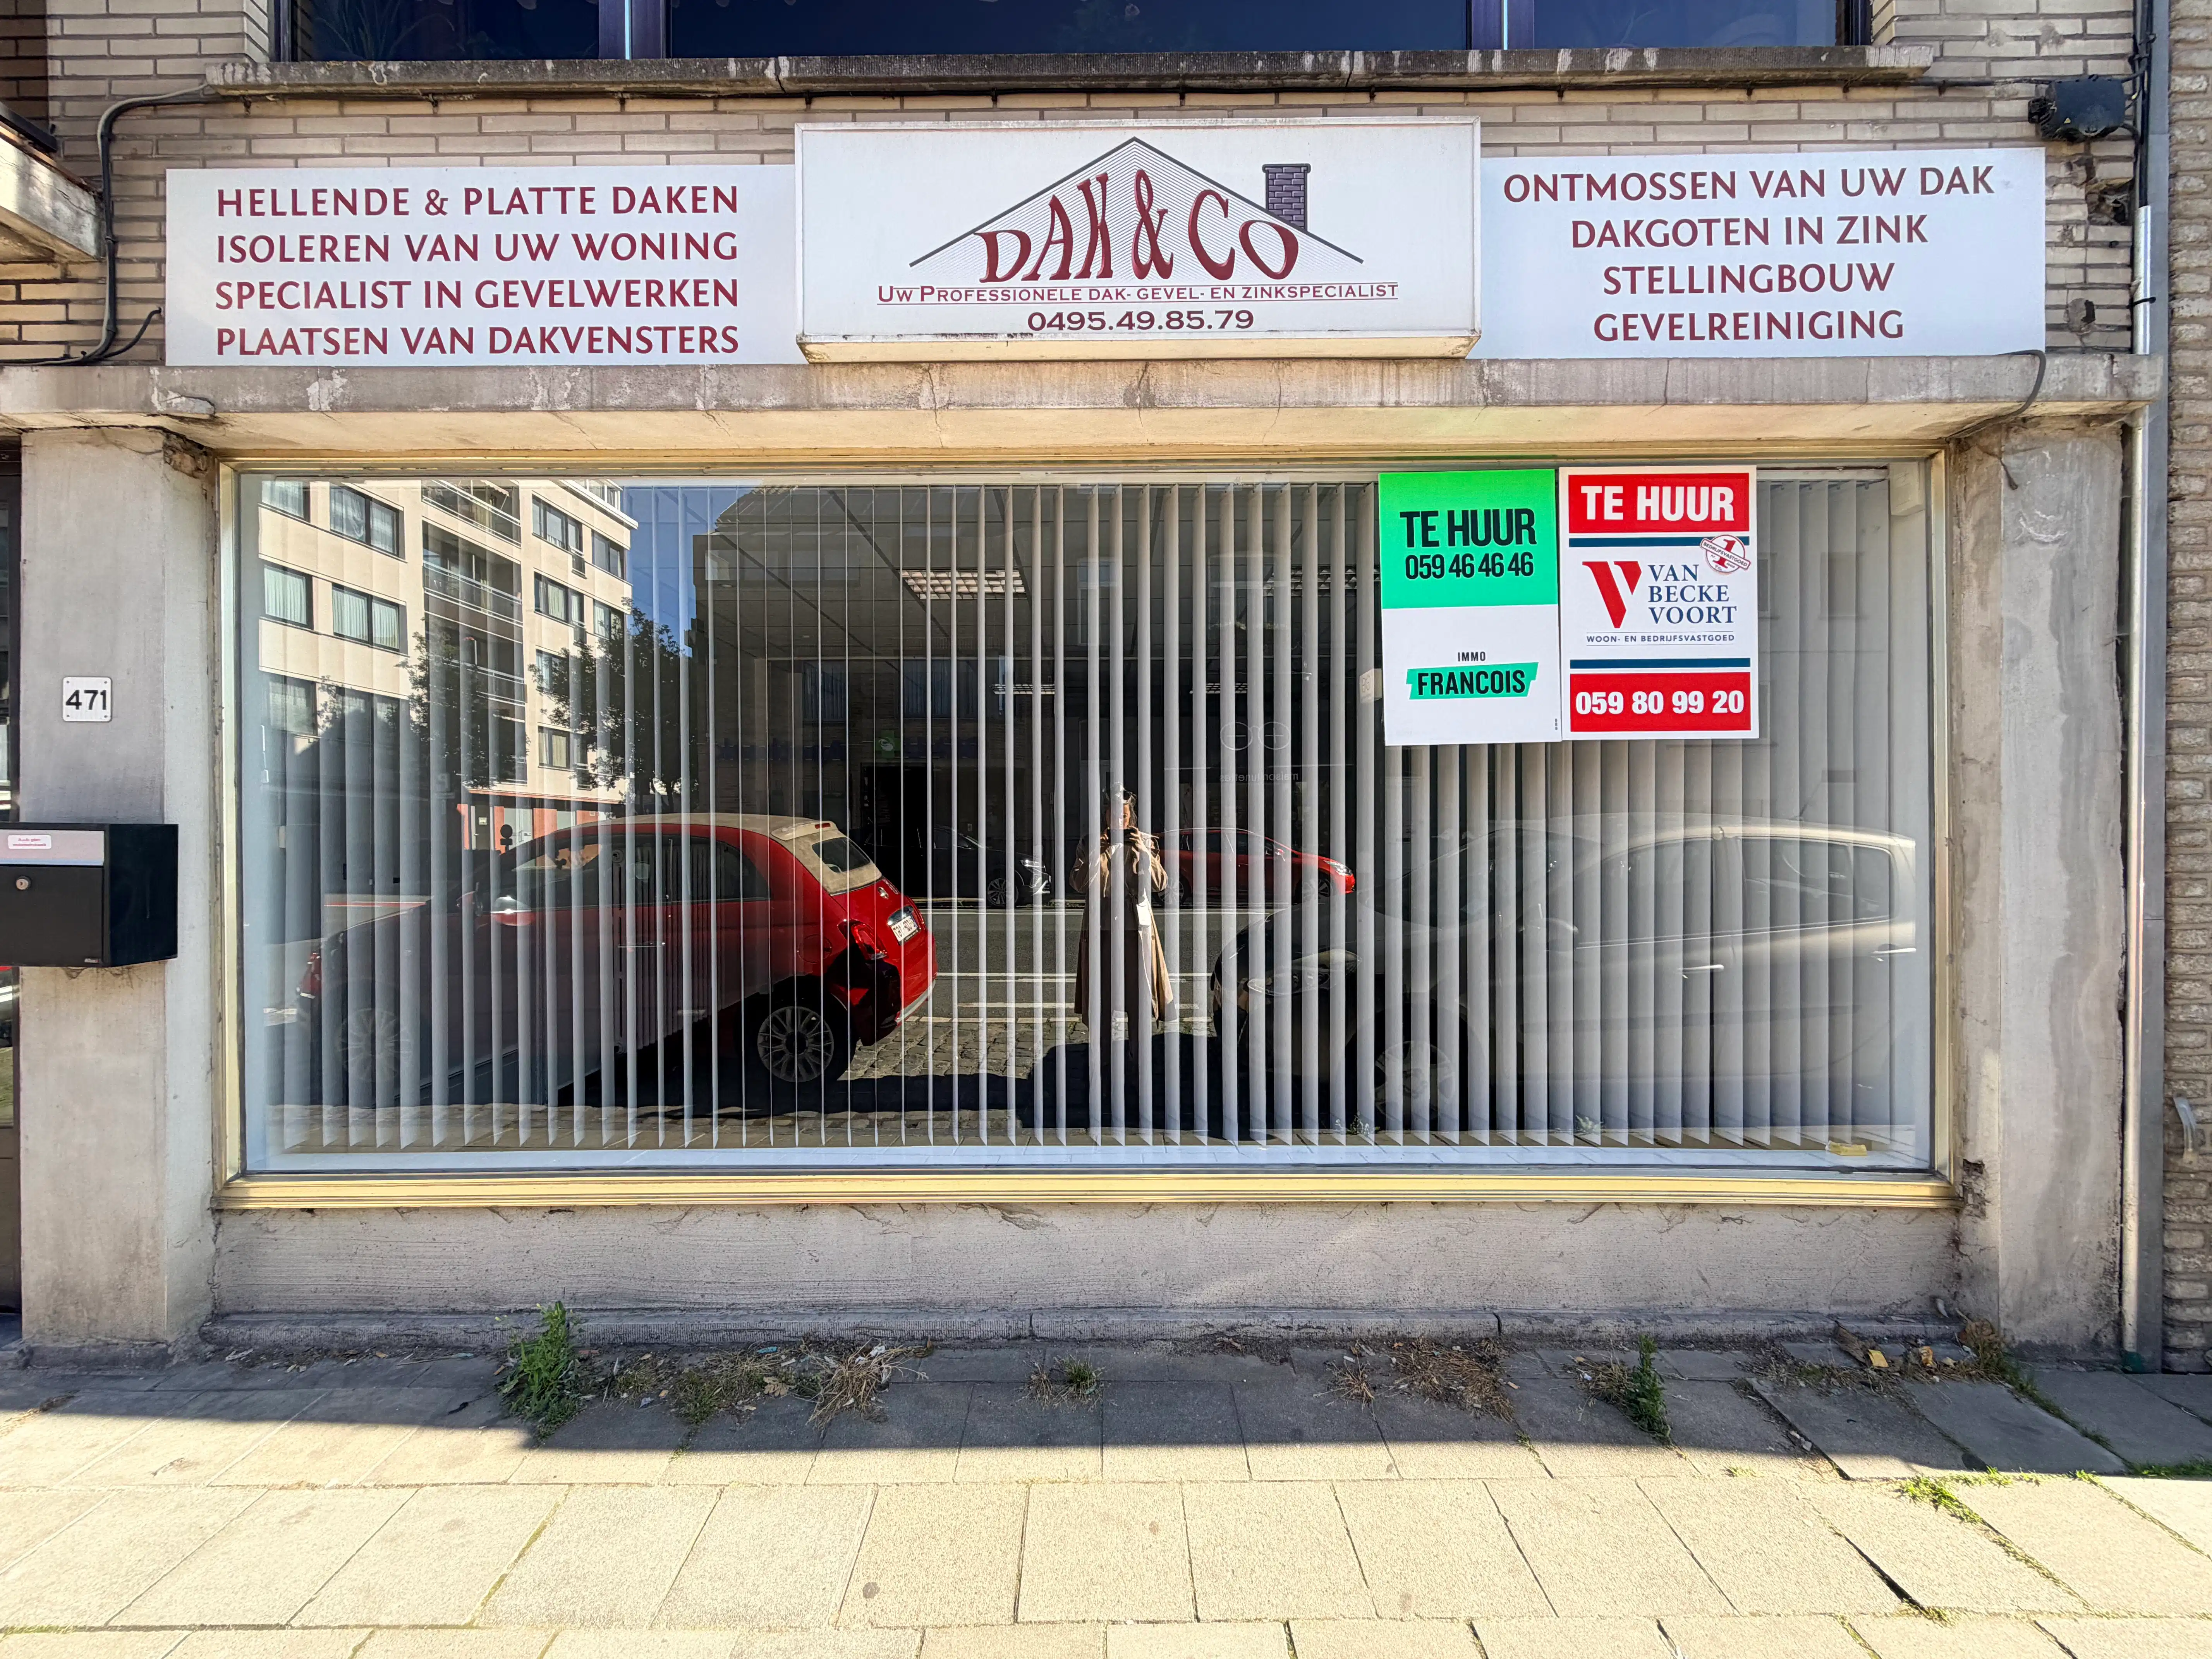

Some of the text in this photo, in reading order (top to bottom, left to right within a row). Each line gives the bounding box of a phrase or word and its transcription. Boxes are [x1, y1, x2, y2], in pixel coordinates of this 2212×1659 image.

[1504, 166, 1994, 203] ONTMOSSEN VAN UW DAK
[218, 186, 737, 216] HELLENDE & PLATTE DAKEN
[978, 170, 1298, 282] DAK & CO
[1572, 214, 1928, 248] DAKGOTEN IN ZINK
[219, 233, 737, 263] ISOLEREN VAN UW WONING
[920, 285, 1082, 302] PROFESSIONELE
[1089, 288, 1131, 301] DAK-
[1137, 287, 1205, 300] GEVEL-
[1211, 287, 1235, 299] EN
[1242, 284, 1398, 299] ZINKSPECIALIST
[1604, 263, 1893, 295] STELLINGBOUW
[216, 279, 737, 309] SPECIALIST IN GEVELWERKEN
[1028, 309, 1254, 331] 0495.49.85.79
[1594, 310, 1904, 342] GEVELREINIGING
[218, 326, 738, 355] PLAATSEN VAN DAKVENSTERS
[1582, 486, 1734, 521] TE HUUR
[1400, 508, 1537, 548] TE HUUR
[1405, 552, 1533, 579] 059 46 46 46
[1703, 542, 1747, 567] BEDRIJFSVASTGOED
[1648, 565, 1699, 581] VAN
[1649, 586, 1729, 602] BECKE
[1648, 606, 1736, 623] VOORT
[1458, 651, 1486, 661] IMMO
[1418, 670, 1525, 695] FRANCOIS
[66, 690, 106, 709] 471
[1576, 690, 1743, 714] 059 80 99 20
